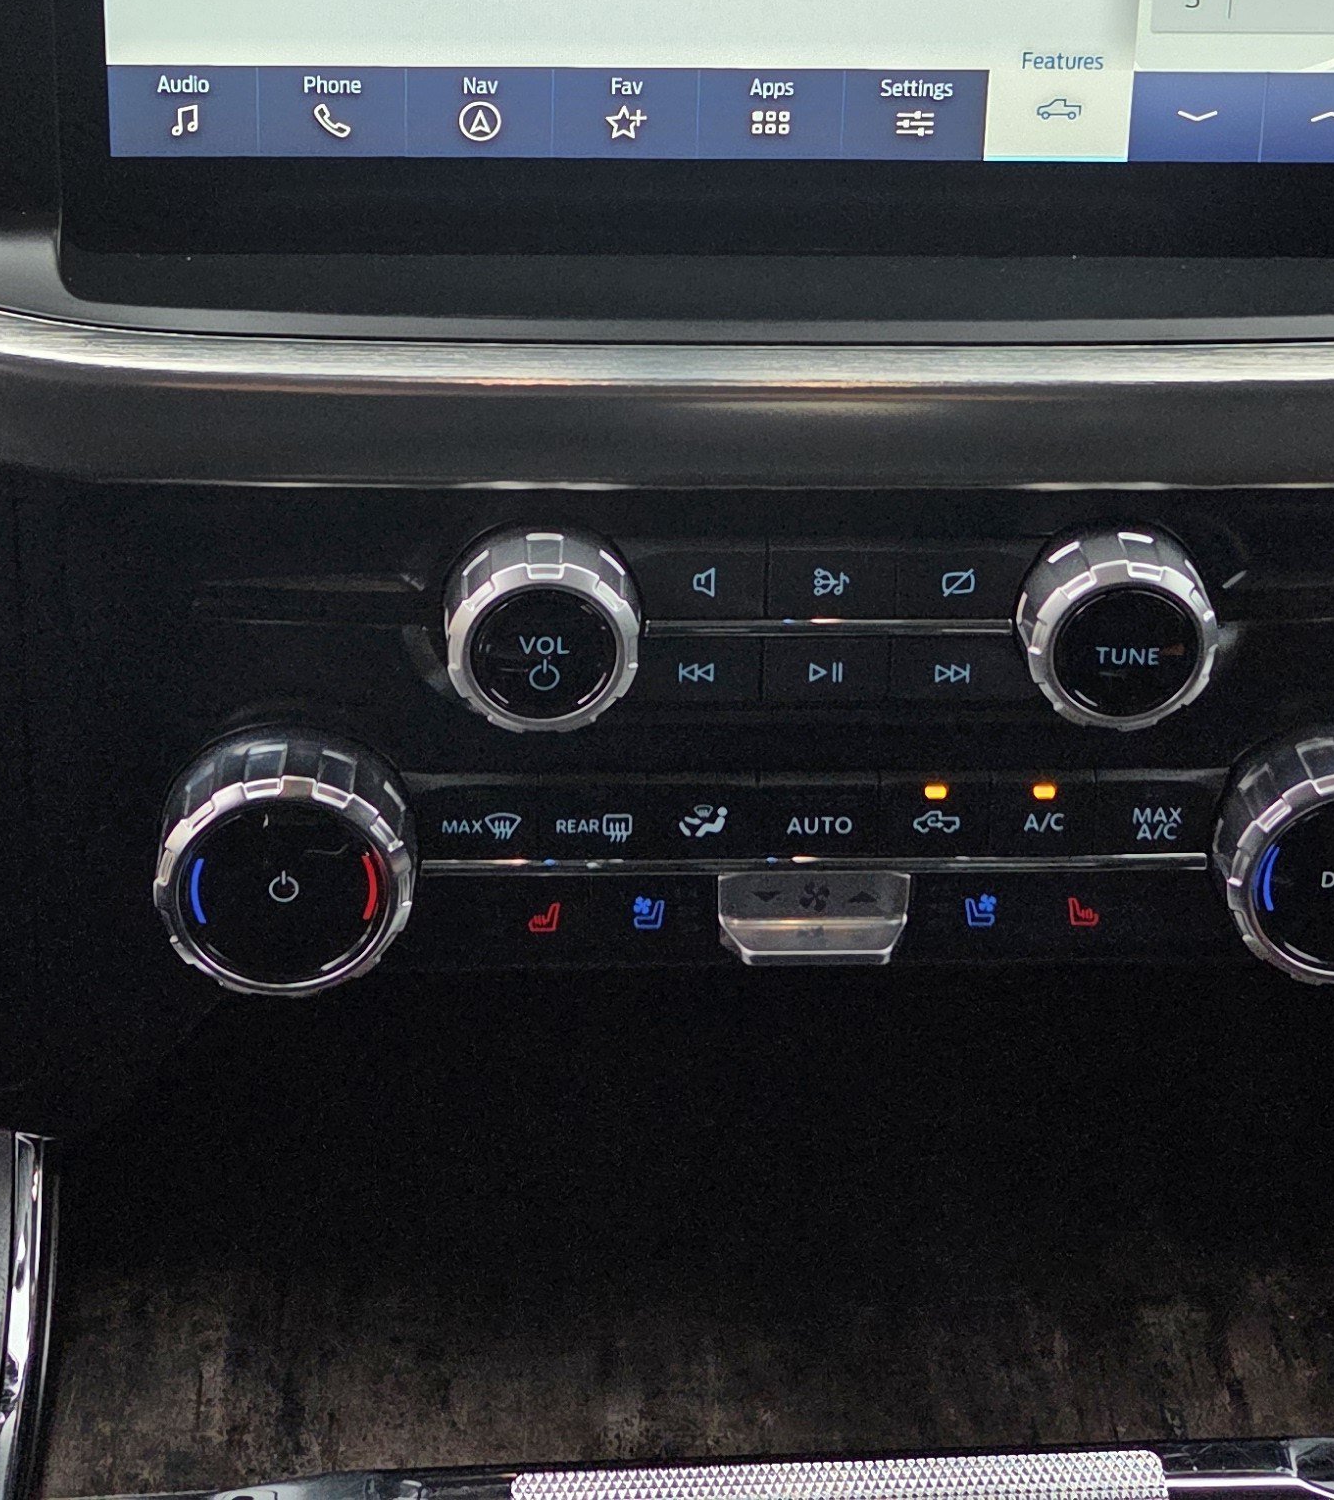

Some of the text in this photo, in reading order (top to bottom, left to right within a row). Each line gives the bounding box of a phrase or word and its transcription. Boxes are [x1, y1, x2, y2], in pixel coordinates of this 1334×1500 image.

[1022, 51, 1104, 71] Features
[157, 75, 210, 94] Audio
[303, 76, 362, 95] Phone
[463, 77, 498, 95] Nav
[611, 78, 643, 96] Fav
[750, 79, 795, 101] Apps
[880, 79, 954, 102] Settings
[519, 637, 570, 656] VOL
[1096, 646, 1160, 667] TUNE
[1024, 812, 1064, 833] A/C
[1132, 807, 1183, 823] MAX
[442, 819, 483, 834] MAX
[556, 819, 600, 835] REAR
[786, 817, 853, 836] AUTO
[1137, 823, 1178, 841] A/C
